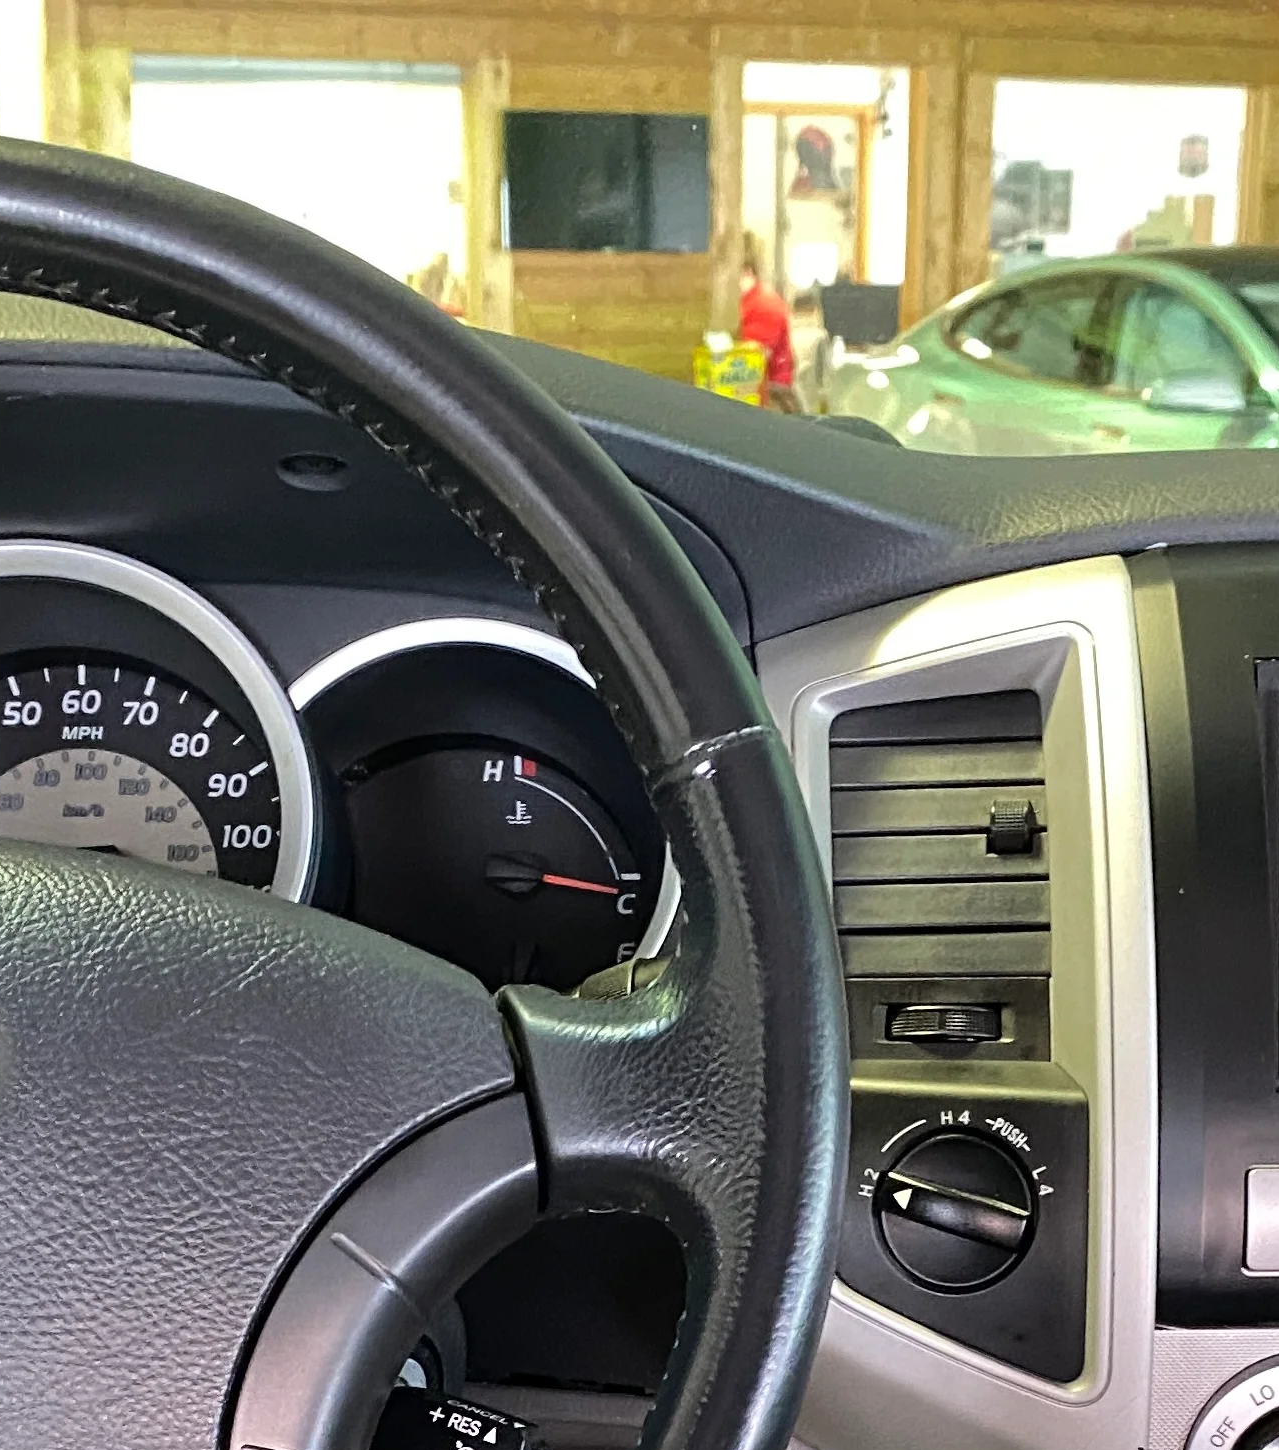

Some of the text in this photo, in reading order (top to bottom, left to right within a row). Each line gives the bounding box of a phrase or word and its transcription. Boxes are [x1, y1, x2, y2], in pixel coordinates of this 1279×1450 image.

[2, 701, 43, 727] 50
[61, 690, 102, 715] 60
[121, 701, 159, 727] 70
[61, 726, 104, 741] MPH
[168, 732, 210, 758] 80
[74, 763, 108, 781] 100
[482, 760, 504, 782] H
[207, 772, 248, 798] 90
[221, 824, 273, 850] 100
[616, 893, 636, 915] C
[1248, 1383, 1276, 1407] LO
[447, 1400, 509, 1425] CANCEL
[447, 1413, 482, 1436] RES
[1210, 1415, 1237, 1449] OFF
